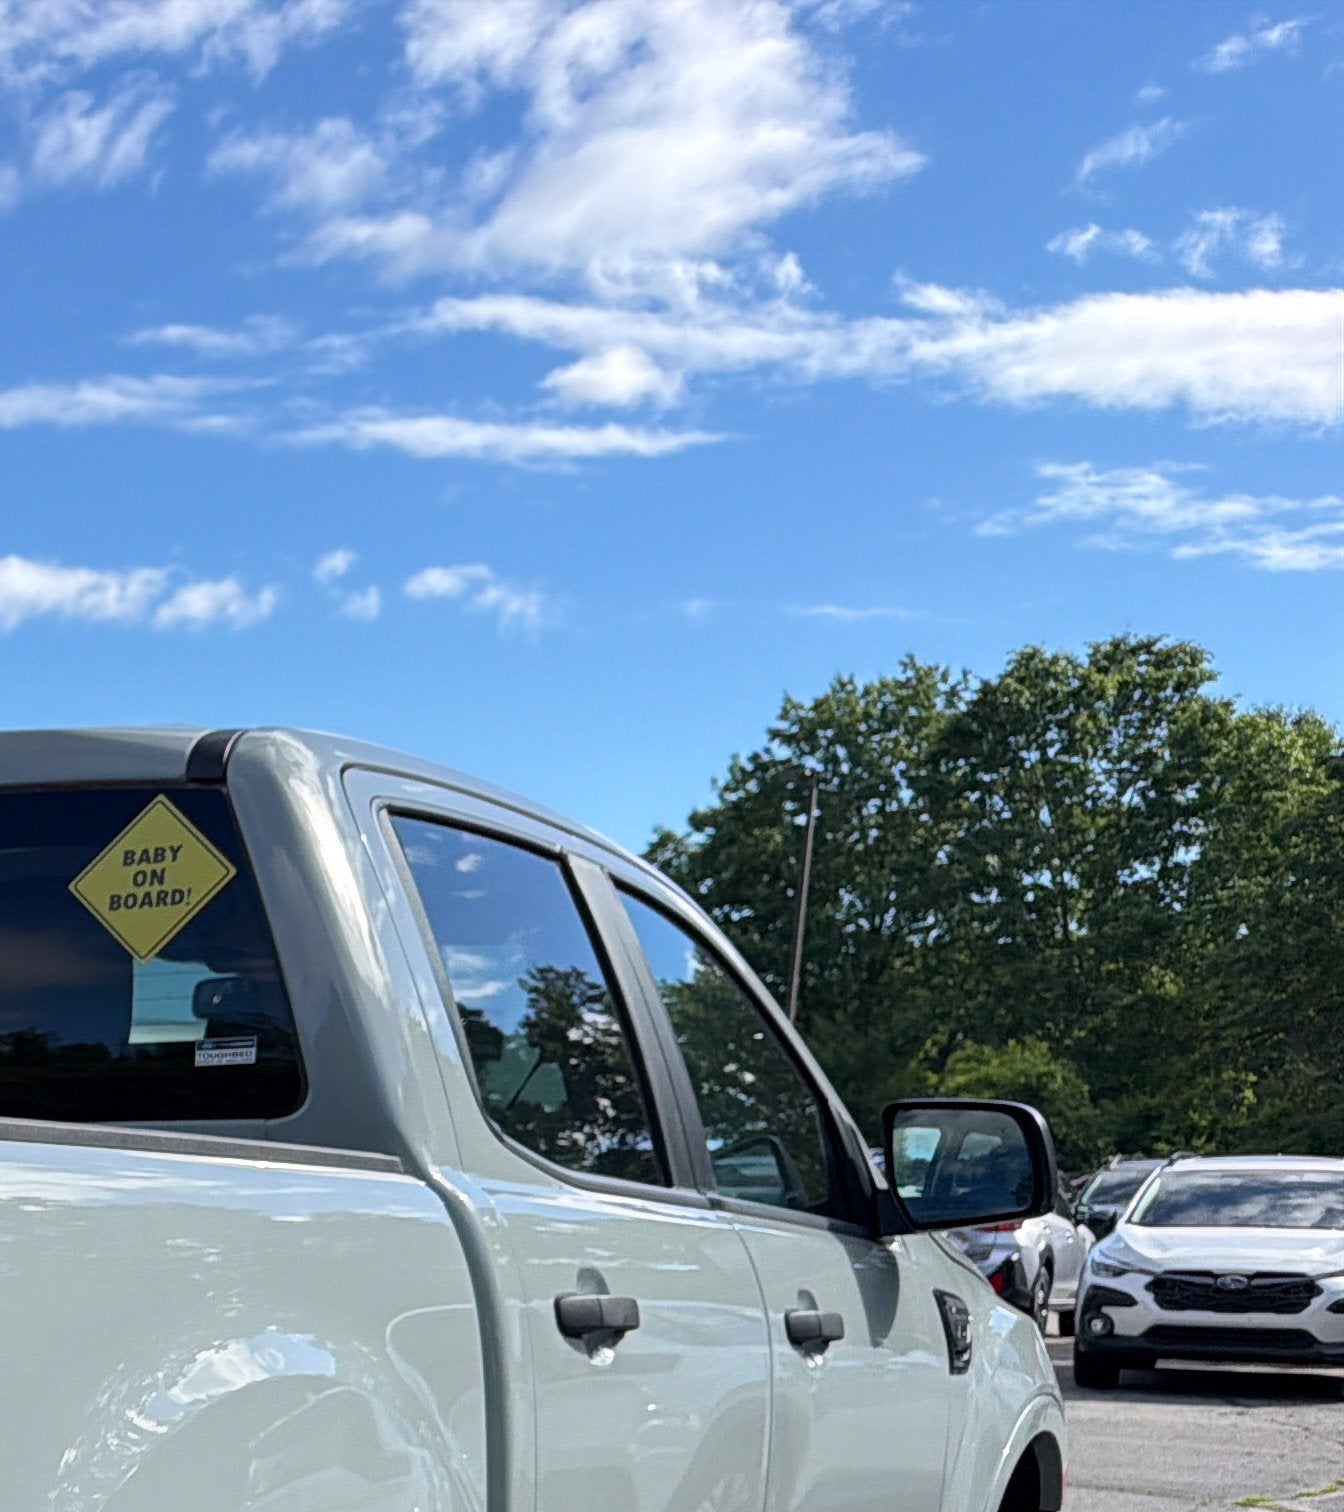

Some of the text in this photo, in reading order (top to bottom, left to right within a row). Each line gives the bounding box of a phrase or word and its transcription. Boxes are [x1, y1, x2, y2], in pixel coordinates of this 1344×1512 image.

[123, 845, 183, 867] BABY
[132, 868, 166, 888] ON
[108, 887, 192, 912] BOARD!
